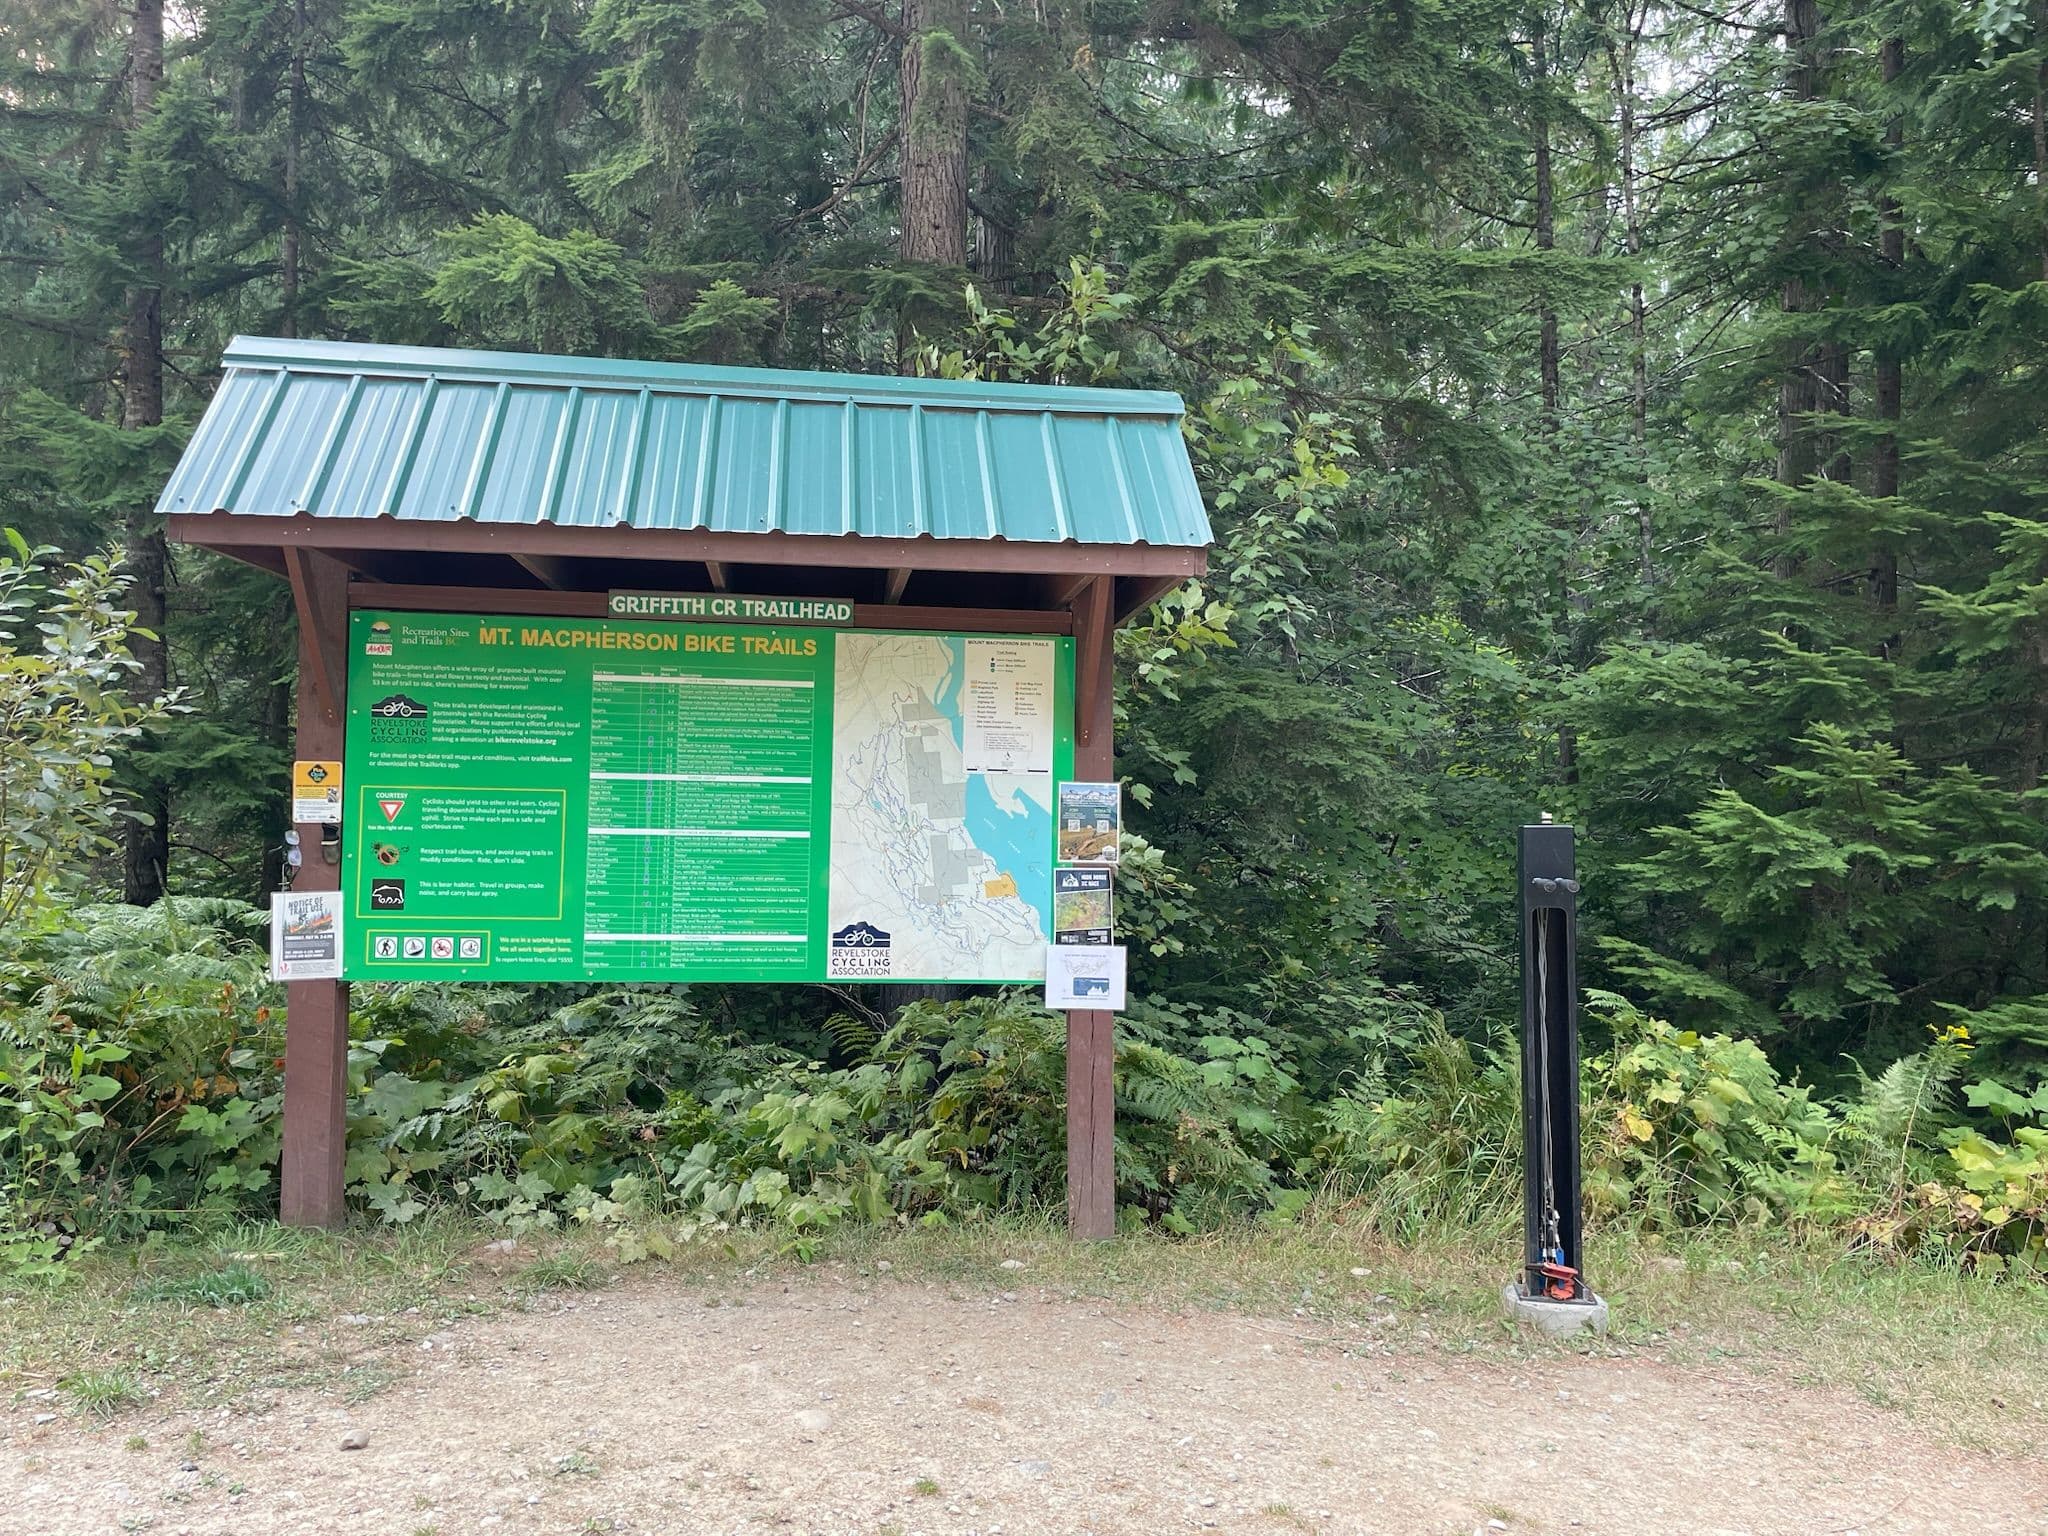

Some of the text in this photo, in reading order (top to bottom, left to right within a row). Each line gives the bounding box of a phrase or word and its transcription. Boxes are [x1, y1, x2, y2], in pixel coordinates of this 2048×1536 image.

[612, 596, 850, 620] GRIFFITH CR TRAILHEAD
[402, 626, 470, 637] Recreation Sites
[402, 636, 418, 644] and
[420, 637, 442, 645] Trails
[479, 628, 817, 656] MT. MACPHERSON BIKE TRAILS
[371, 719, 427, 727] REVELSTOKE
[371, 728, 427, 736] CYCLING
[371, 736, 427, 744] ASSOCIATION
[288, 896, 323, 908] NOTICE OF
[290, 904, 323, 915] TRAIL USE
[832, 949, 890, 957] REVELSTOKE
[832, 958, 890, 966] CYCLING
[832, 967, 890, 975] ASSOCIATION
